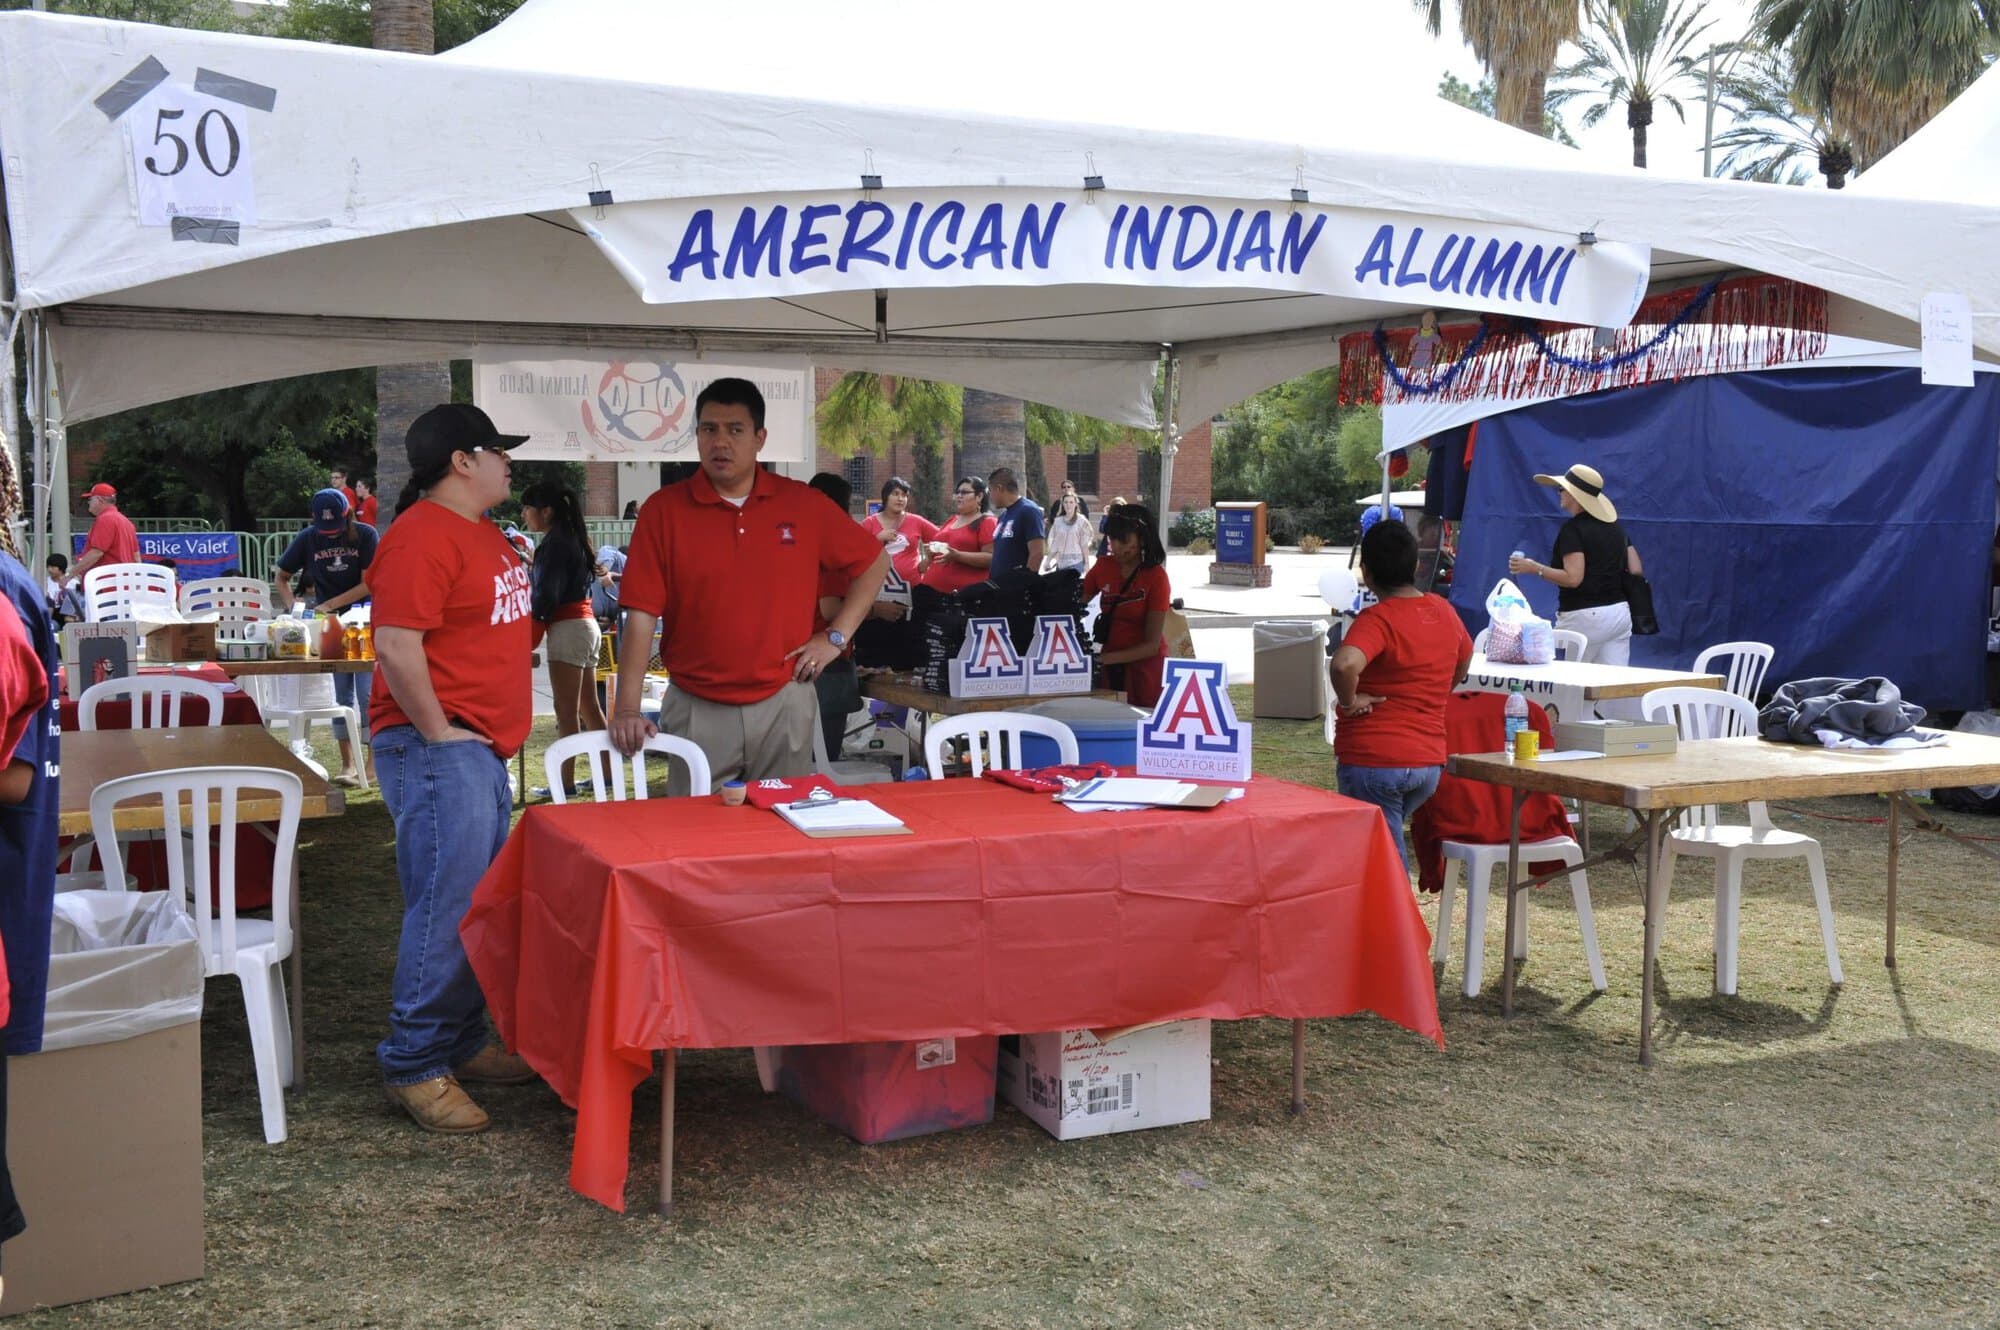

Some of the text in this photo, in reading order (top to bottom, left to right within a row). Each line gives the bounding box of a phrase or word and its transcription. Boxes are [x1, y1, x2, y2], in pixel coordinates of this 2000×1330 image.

[144, 109, 240, 177] 50
[667, 200, 1067, 282] AMERICAN
[1104, 204, 1328, 275] INDIAN
[1355, 224, 1577, 306] ALUMNI
[145, 539, 229, 555] Bike Valet
[74, 626, 129, 639] RED INK
[1143, 660, 1238, 753] A
[1142, 757, 1238, 773] WILDCAT FOR LIFE
